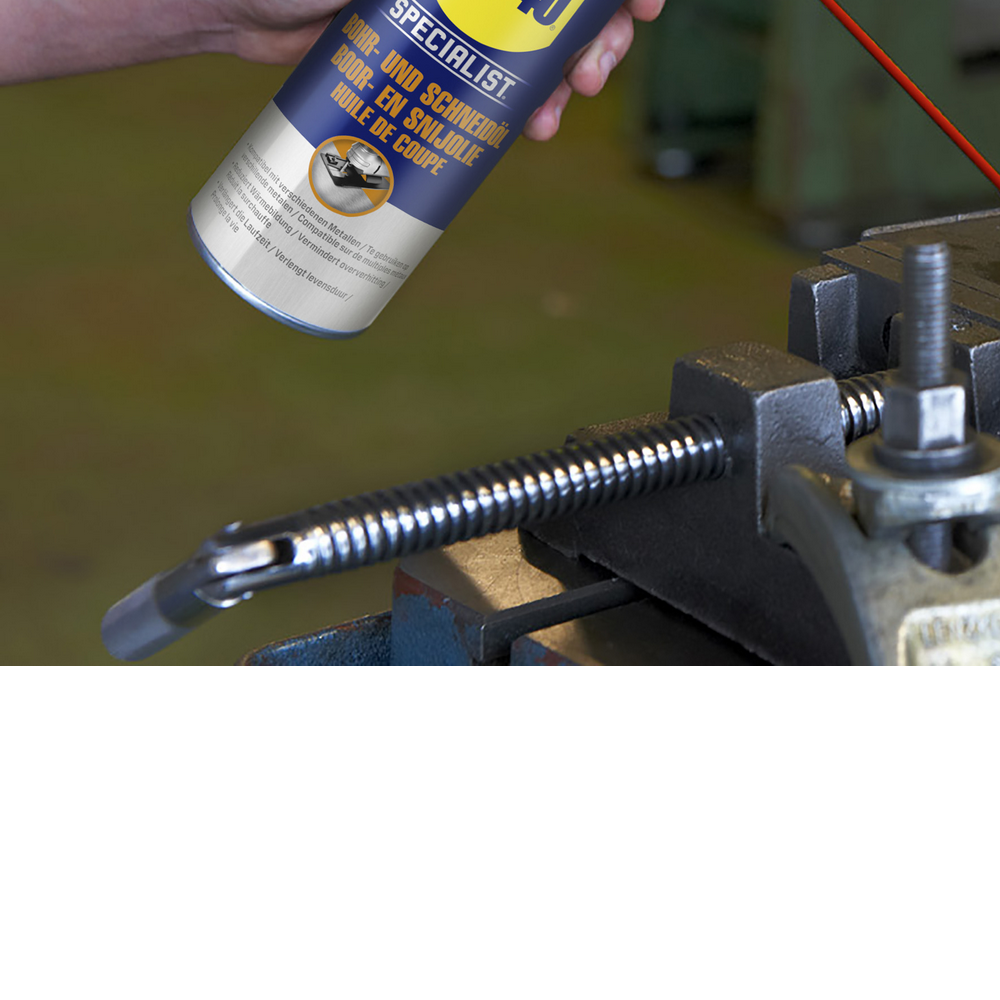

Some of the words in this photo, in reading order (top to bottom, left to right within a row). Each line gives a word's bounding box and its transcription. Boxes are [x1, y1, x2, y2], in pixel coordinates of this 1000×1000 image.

[330, 43, 374, 91] BOOR-
[374, 84, 408, 118] EN
[403, 107, 485, 167] SNIJOLIE
[330, 81, 375, 126] HUILE
[369, 115, 397, 143] DE
[392, 133, 448, 176] COUPE
[341, 12, 380, 57] BOHR-
[380, 49, 424, 92] UND
[420, 82, 510, 149] SCHNEIDÖL
[224, 212, 231, 224] la
[229, 221, 240, 234] vie
[233, 162, 252, 189] Reduziert
[249, 185, 293, 234] Wärmebildung
[298, 233, 341, 266] Vermindert
[236, 186, 243, 196] la
[240, 192, 272, 229] surchauffe
[241, 153, 269, 188] verschillende
[267, 185, 294, 214] metalen
[297, 213, 340, 248] Compatible
[339, 245, 353, 256] sur
[352, 252, 363, 262] de
[361, 257, 391, 275] multiples
[249, 143, 272, 174] Kompatibel
[268, 171, 280, 184] mit
[278, 181, 328, 227] verschiedenen
[327, 222, 361, 248] Metallen
[366, 245, 375, 256] Te
[235, 209, 246, 223] die
[243, 218, 271, 249] Laufzeit
[274, 249, 307, 277] Verlengt
[305, 271, 348, 300] levensduur
